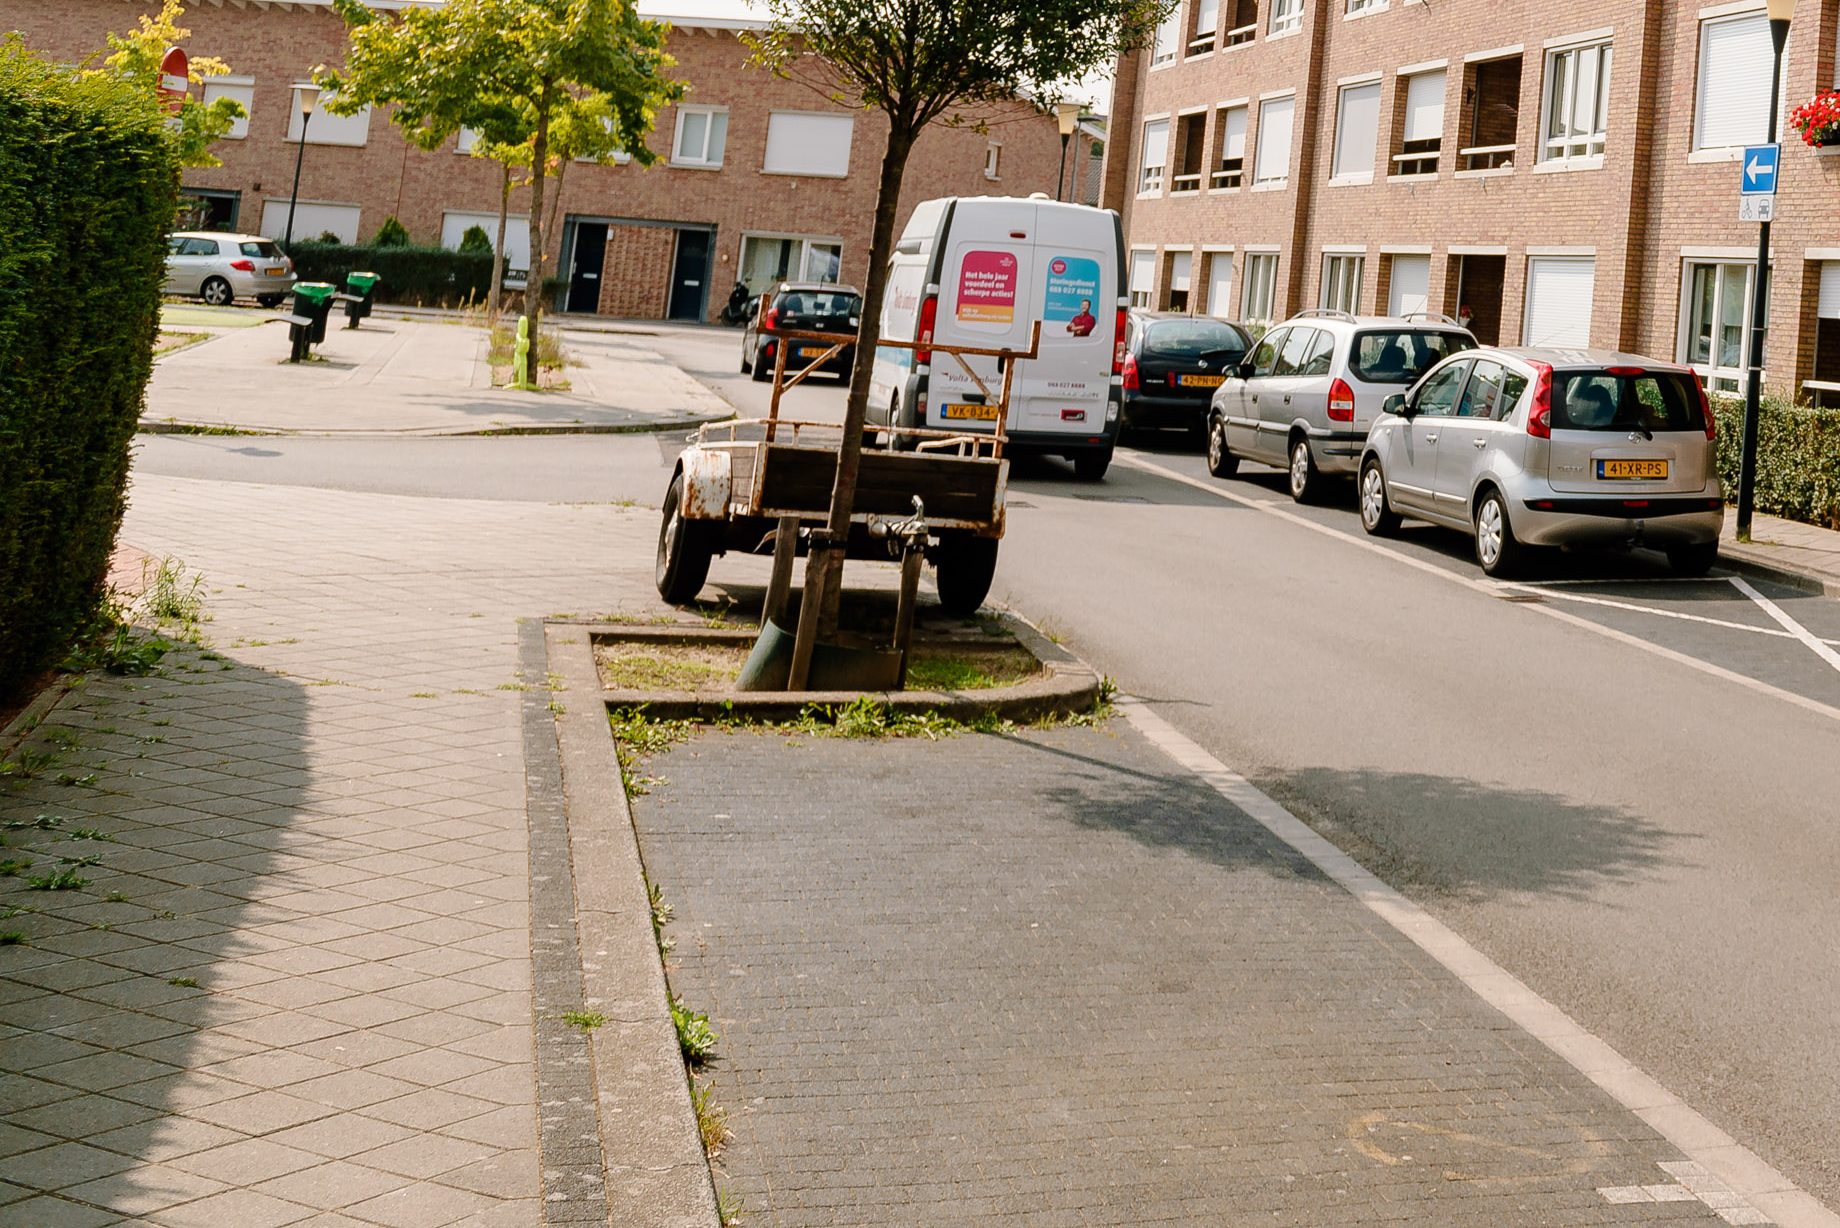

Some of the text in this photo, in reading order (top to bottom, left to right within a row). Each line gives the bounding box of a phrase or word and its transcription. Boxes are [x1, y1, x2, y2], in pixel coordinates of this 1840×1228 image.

[964, 271, 1009, 281] Het hele jaar
[964, 280, 995, 288] voordeel
[963, 288, 1013, 298] scherpe acties!
[948, 373, 969, 382] Volta
[1610, 463, 1662, 475] 41-XR-PS
